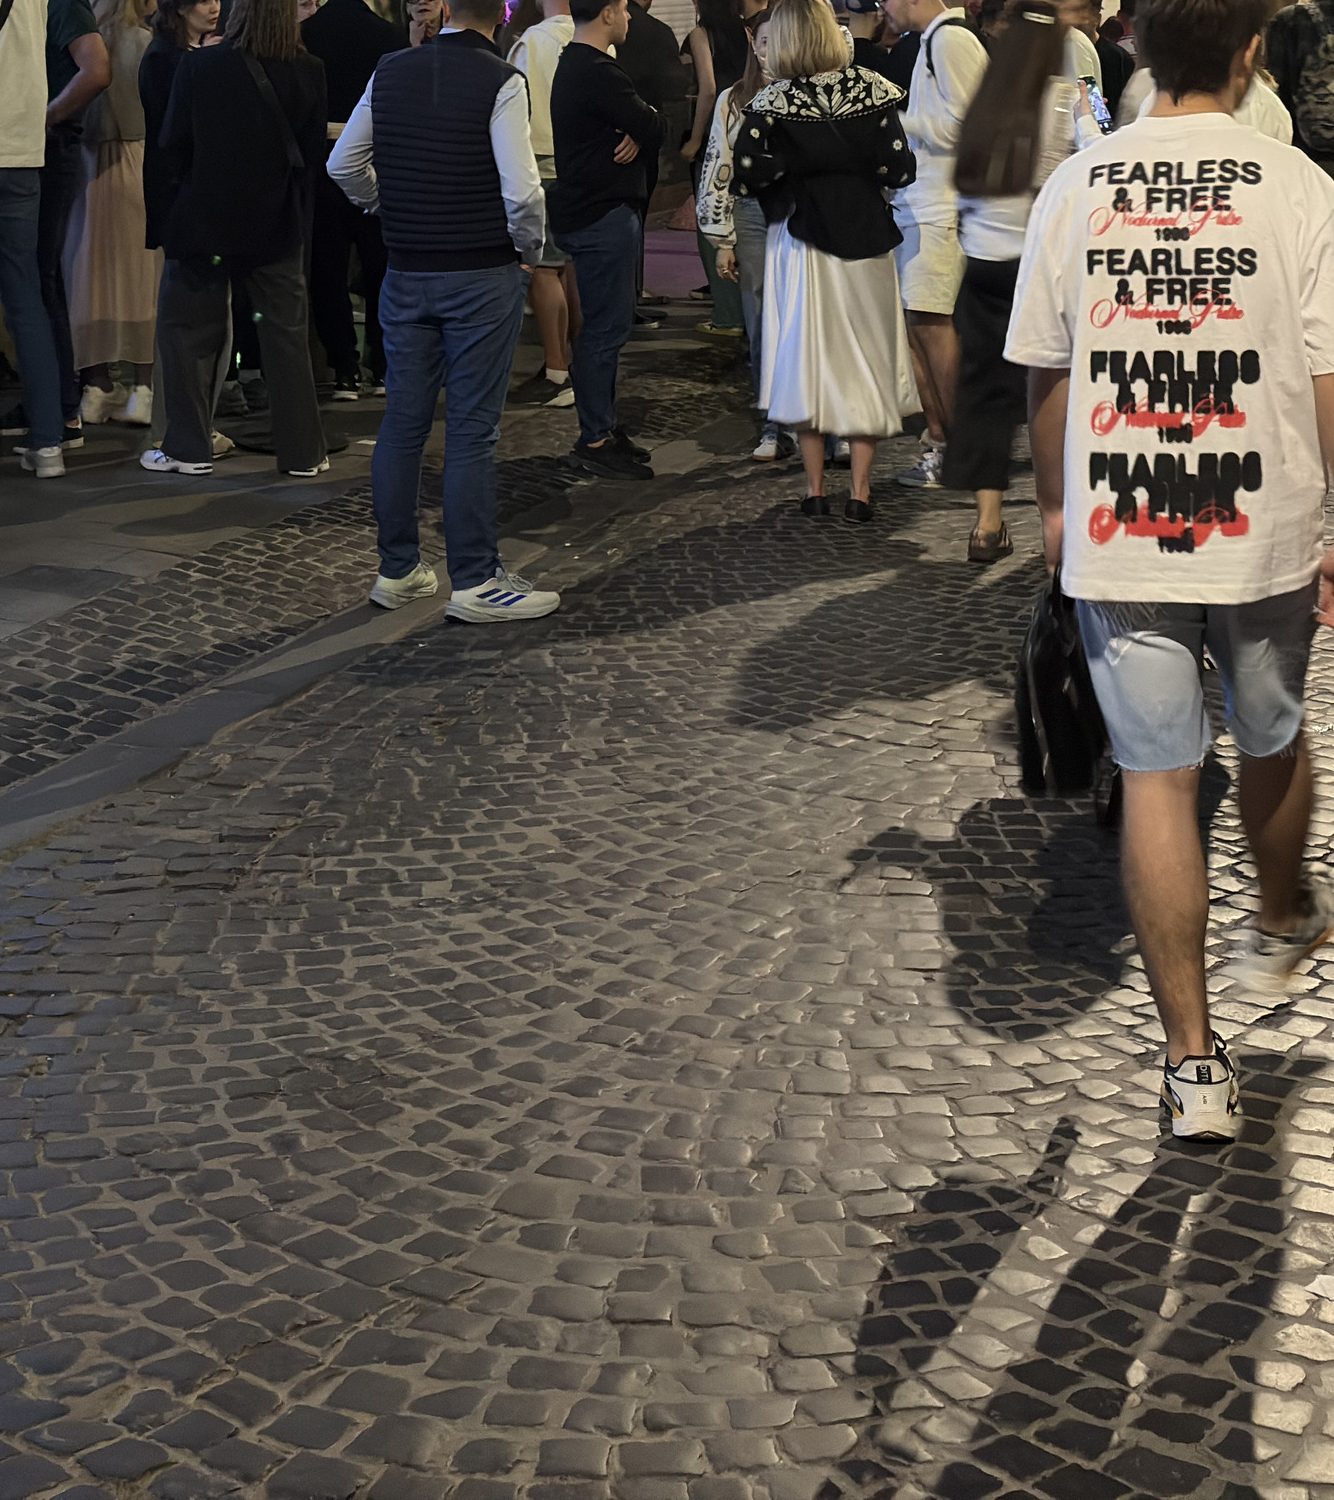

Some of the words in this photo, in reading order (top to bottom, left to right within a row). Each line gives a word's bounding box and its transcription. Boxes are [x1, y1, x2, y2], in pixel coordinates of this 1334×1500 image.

[1089, 159, 1262, 187] FEARLESS
[1112, 187, 1133, 212] &
[1146, 185, 1233, 212] FREE
[1087, 247, 1258, 276] FEARLESS
[1115, 278, 1134, 305] &
[1146, 277, 1232, 305] FREE
